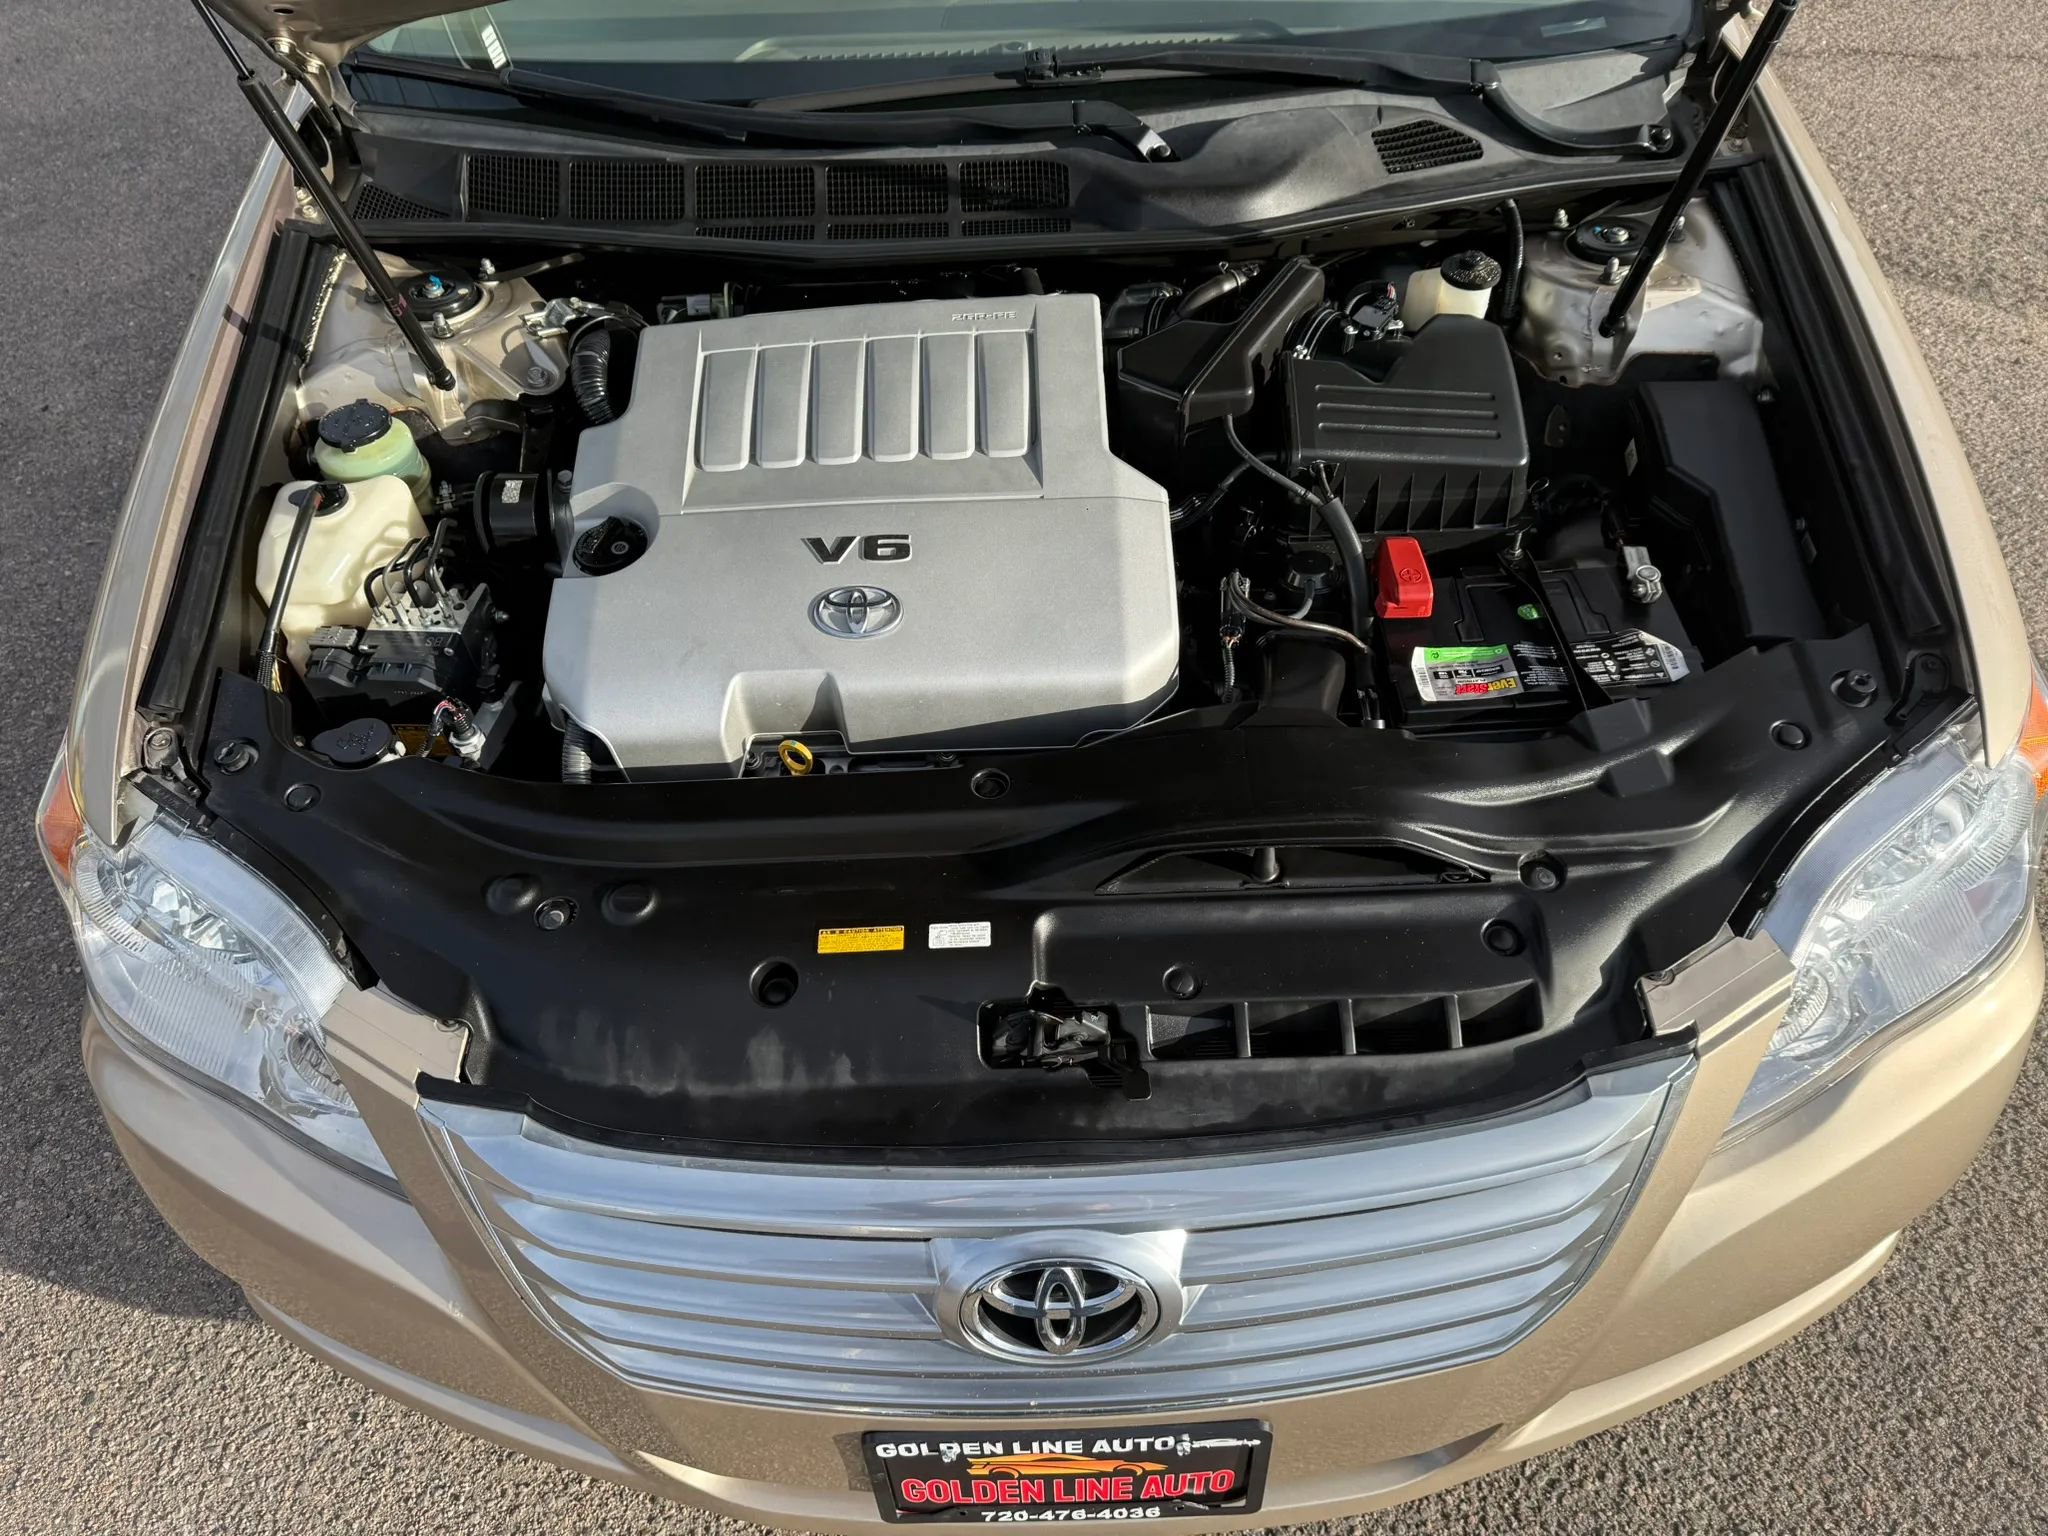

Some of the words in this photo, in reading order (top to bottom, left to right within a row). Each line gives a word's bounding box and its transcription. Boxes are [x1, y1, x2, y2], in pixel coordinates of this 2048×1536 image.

[801, 534, 912, 565] V6
[876, 1440, 1003, 1458] GOLDEN
[1013, 1439, 1083, 1455] LINE
[1092, 1436, 1176, 1453] AUTO
[901, 1478, 1045, 1504] GOLDEN
[1054, 1476, 1133, 1502] LINE
[1141, 1470, 1235, 1500] AUTO
[981, 1506, 1160, 1522] 720-476-4036
